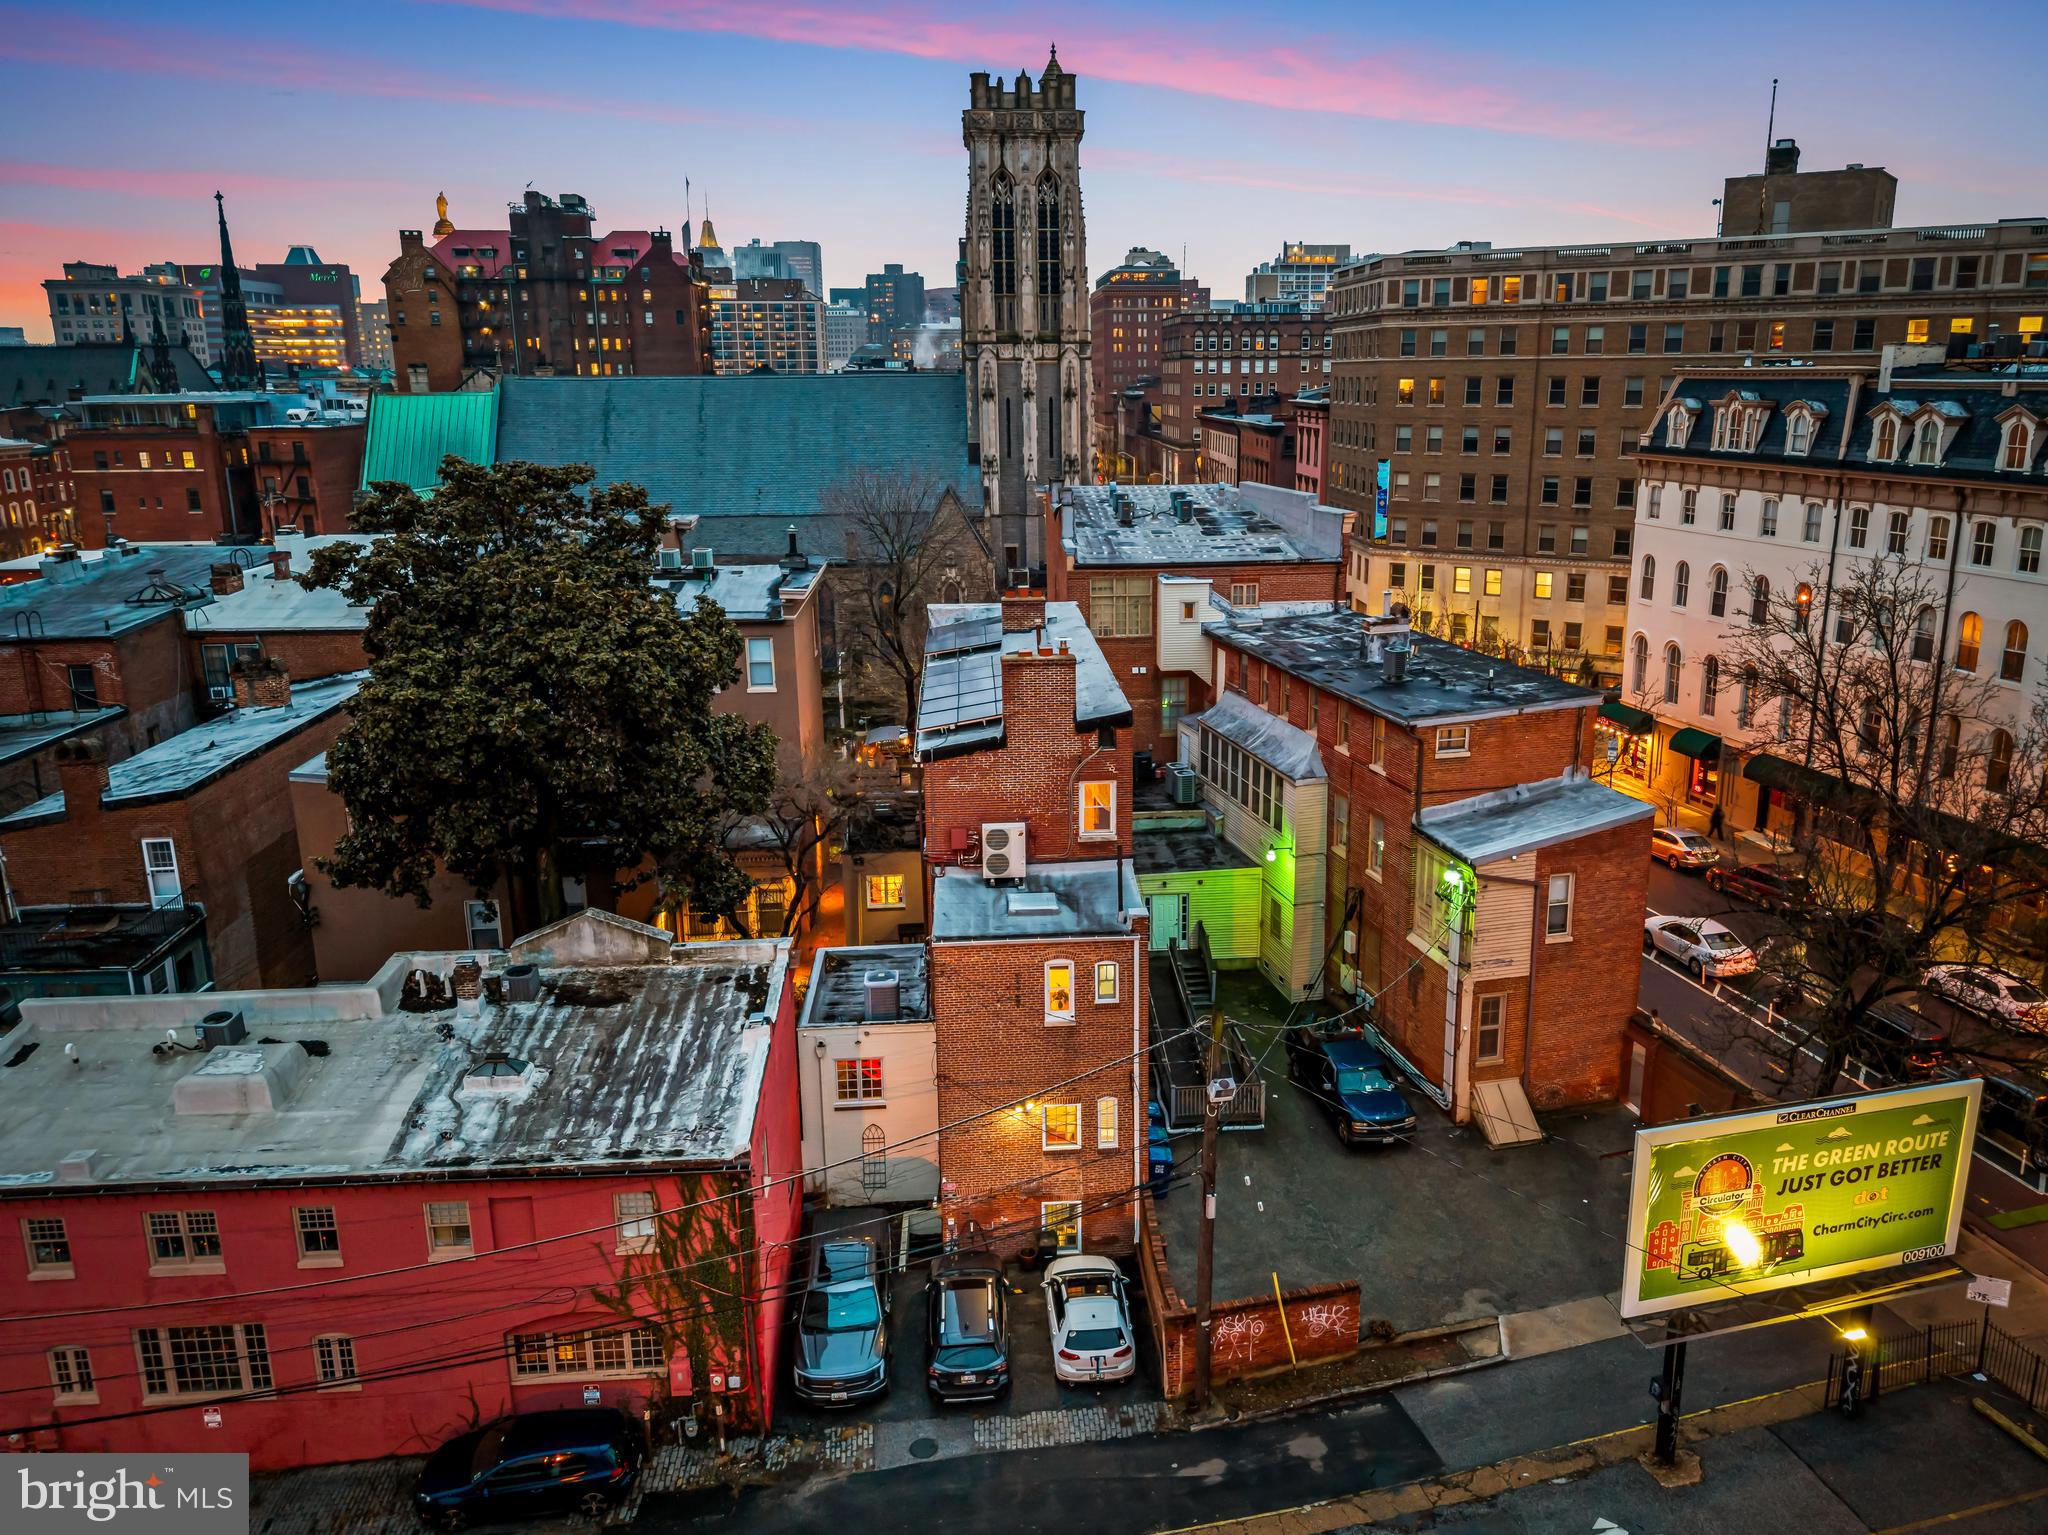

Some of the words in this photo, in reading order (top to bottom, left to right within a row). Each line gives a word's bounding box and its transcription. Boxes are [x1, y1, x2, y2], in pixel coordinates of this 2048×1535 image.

[309, 271, 339, 283] Mercy
[1772, 1153, 1809, 1175] THE
[1813, 1142, 1881, 1168] GREEN
[1885, 1130, 1950, 1156] ROUTE
[1703, 1155, 1728, 1172] CHARM
[1732, 1155, 1748, 1166] CITY
[1776, 1172, 1826, 1196] JUST
[1829, 1164, 1874, 1187] GOT
[1877, 1153, 1943, 1179] BETTER
[1700, 1192, 1745, 1206] Circulator
[1854, 1186, 1889, 1206] dot
[1813, 1207, 1934, 1237] CharmCityCirc.com
[1903, 1245, 1945, 1263] 009100
